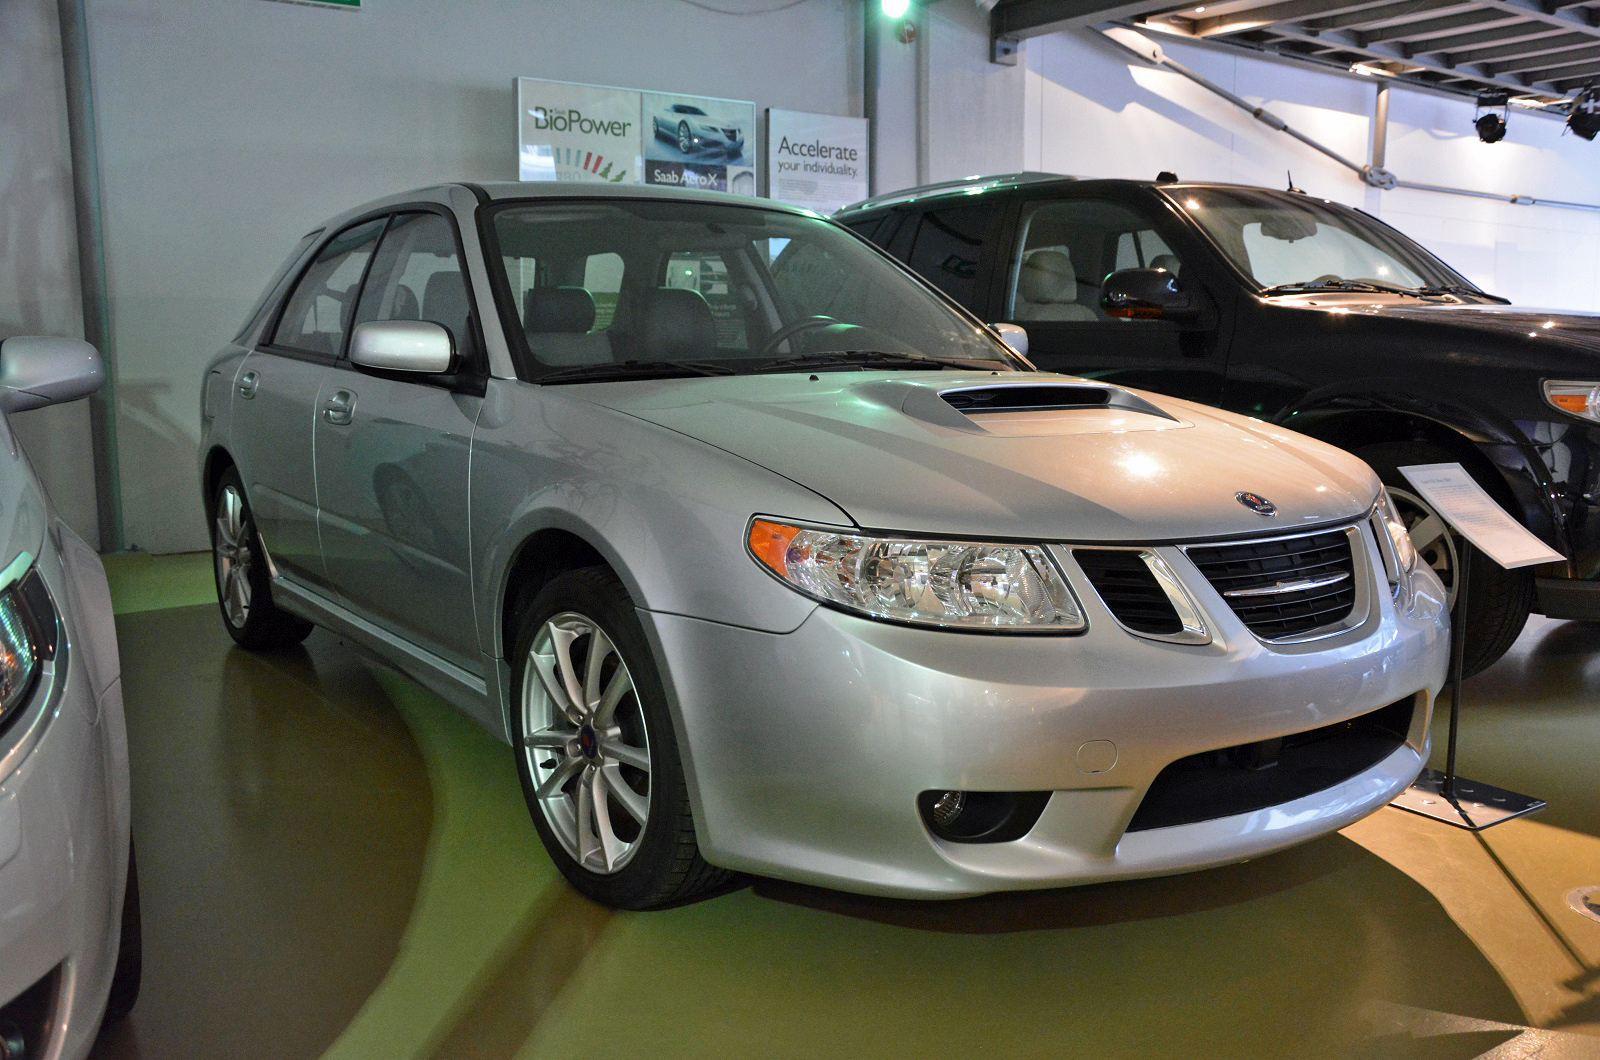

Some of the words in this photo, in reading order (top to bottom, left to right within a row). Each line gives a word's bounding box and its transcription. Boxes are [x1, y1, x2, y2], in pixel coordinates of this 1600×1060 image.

[534, 106, 631, 137] BioPower
[778, 135, 858, 161] Accelerate
[654, 169, 679, 183] Saab
[778, 160, 800, 173] your
[803, 160, 858, 179] individuality.
